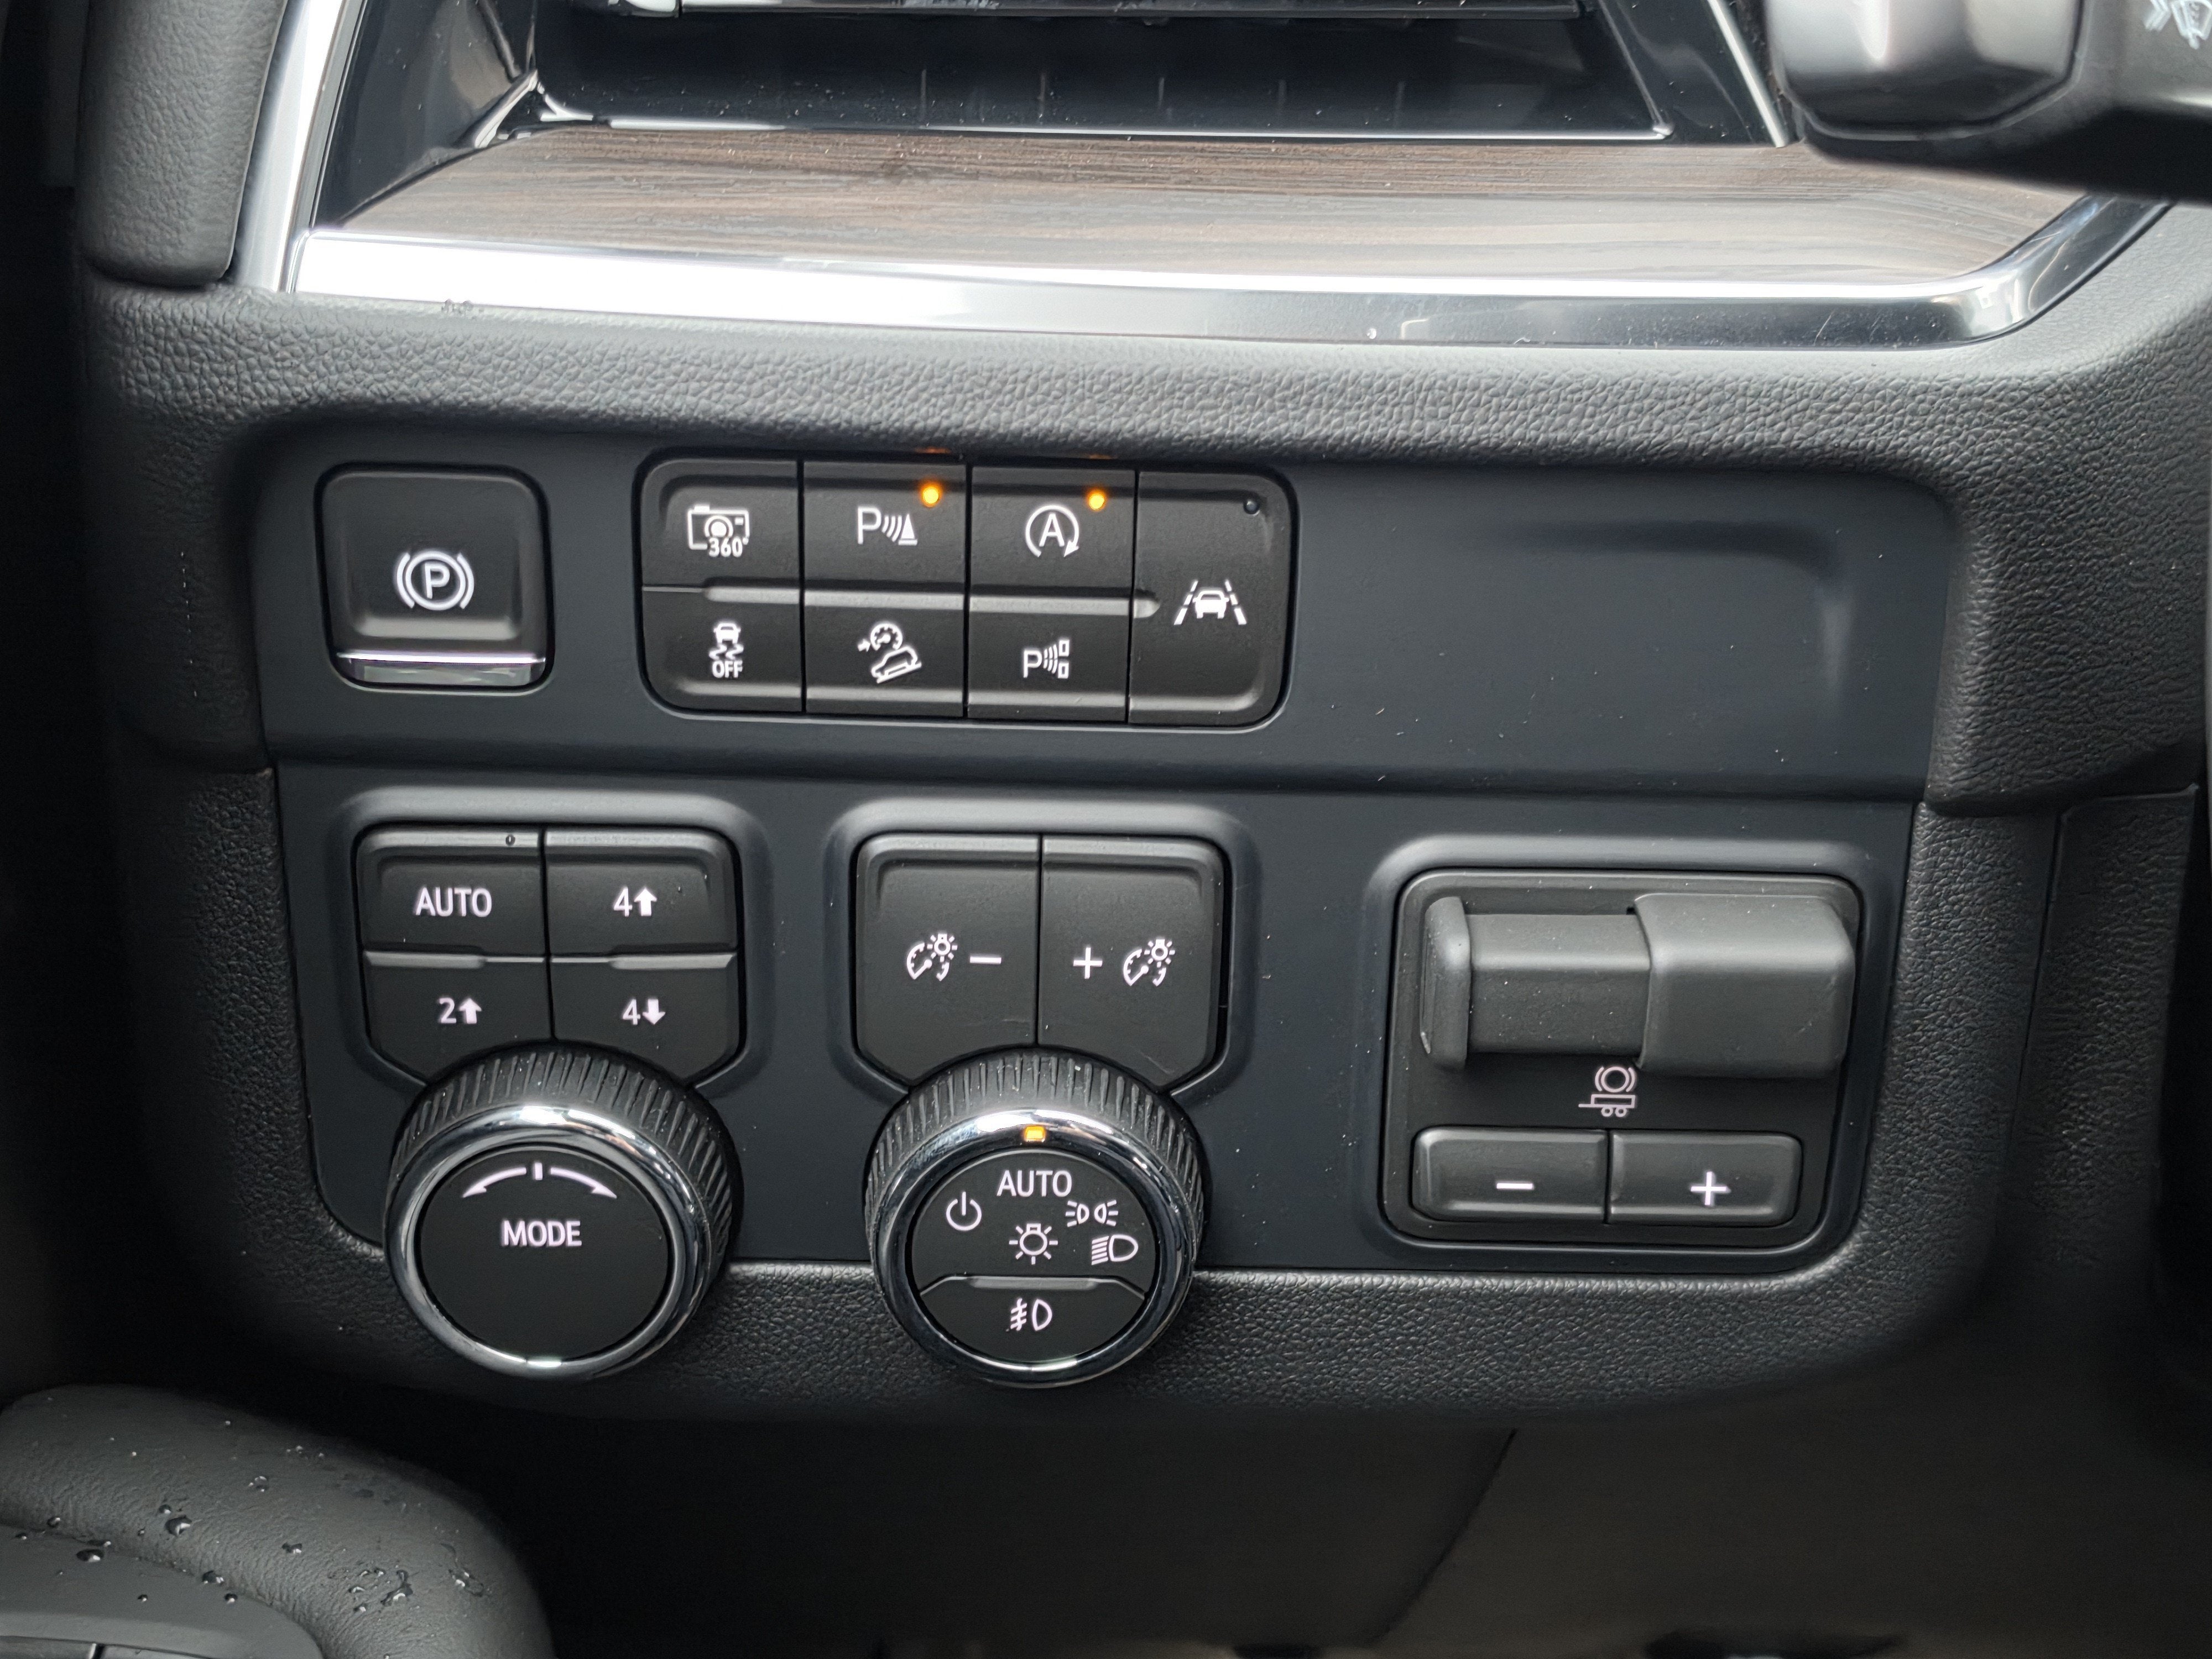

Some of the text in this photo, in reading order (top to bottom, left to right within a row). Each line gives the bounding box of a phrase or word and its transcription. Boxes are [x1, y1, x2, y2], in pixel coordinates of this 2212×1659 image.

[856, 504, 880, 545] P
[1038, 512, 1066, 546] A
[424, 562, 450, 599] P
[711, 661, 743, 679] OFF
[1023, 649, 1042, 678] P
[415, 886, 492, 917] AUTO
[613, 886, 633, 917] 4
[439, 997, 457, 1024] 2
[622, 998, 641, 1025] 4
[997, 1170, 1073, 1197] AUTO
[502, 1220, 582, 1247] MODE
